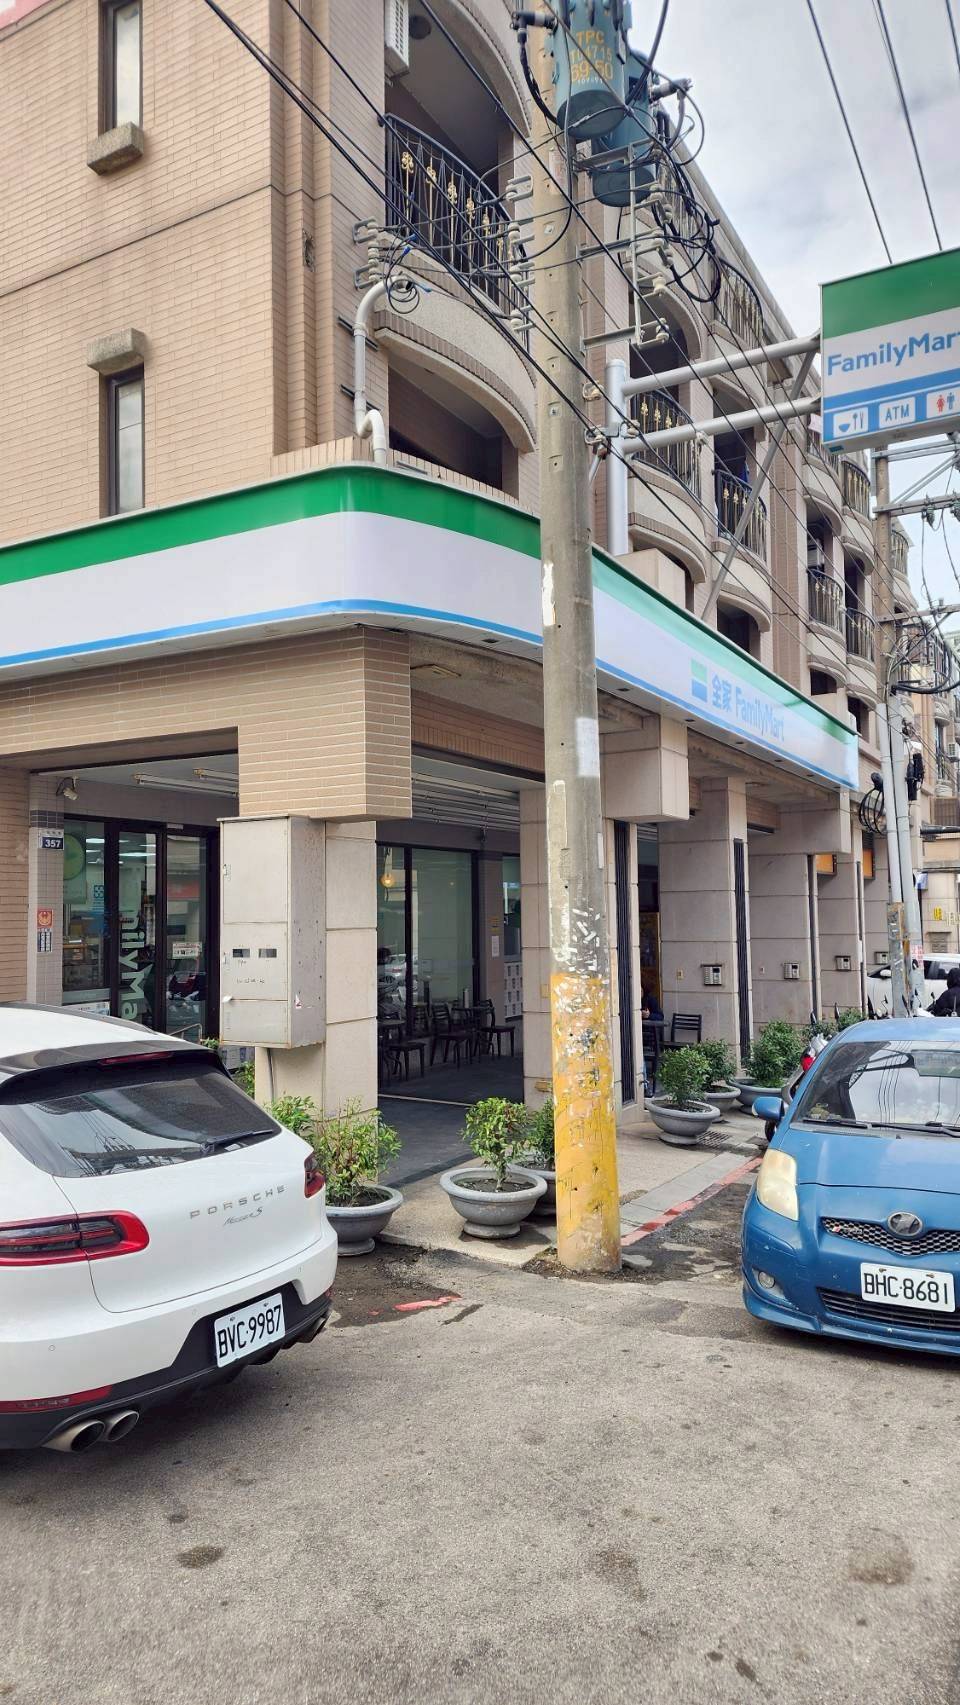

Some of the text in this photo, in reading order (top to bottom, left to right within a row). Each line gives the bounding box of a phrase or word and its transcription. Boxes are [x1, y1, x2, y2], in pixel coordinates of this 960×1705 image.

[827, 331, 960, 376] FamilyMar
[885, 404, 910, 422] ATM
[711, 675, 732, 712] 全家
[735, 686, 785, 742] FamilyMart
[45, 838, 61, 849] 357
[189, 1184, 286, 1220] PORSCHE
